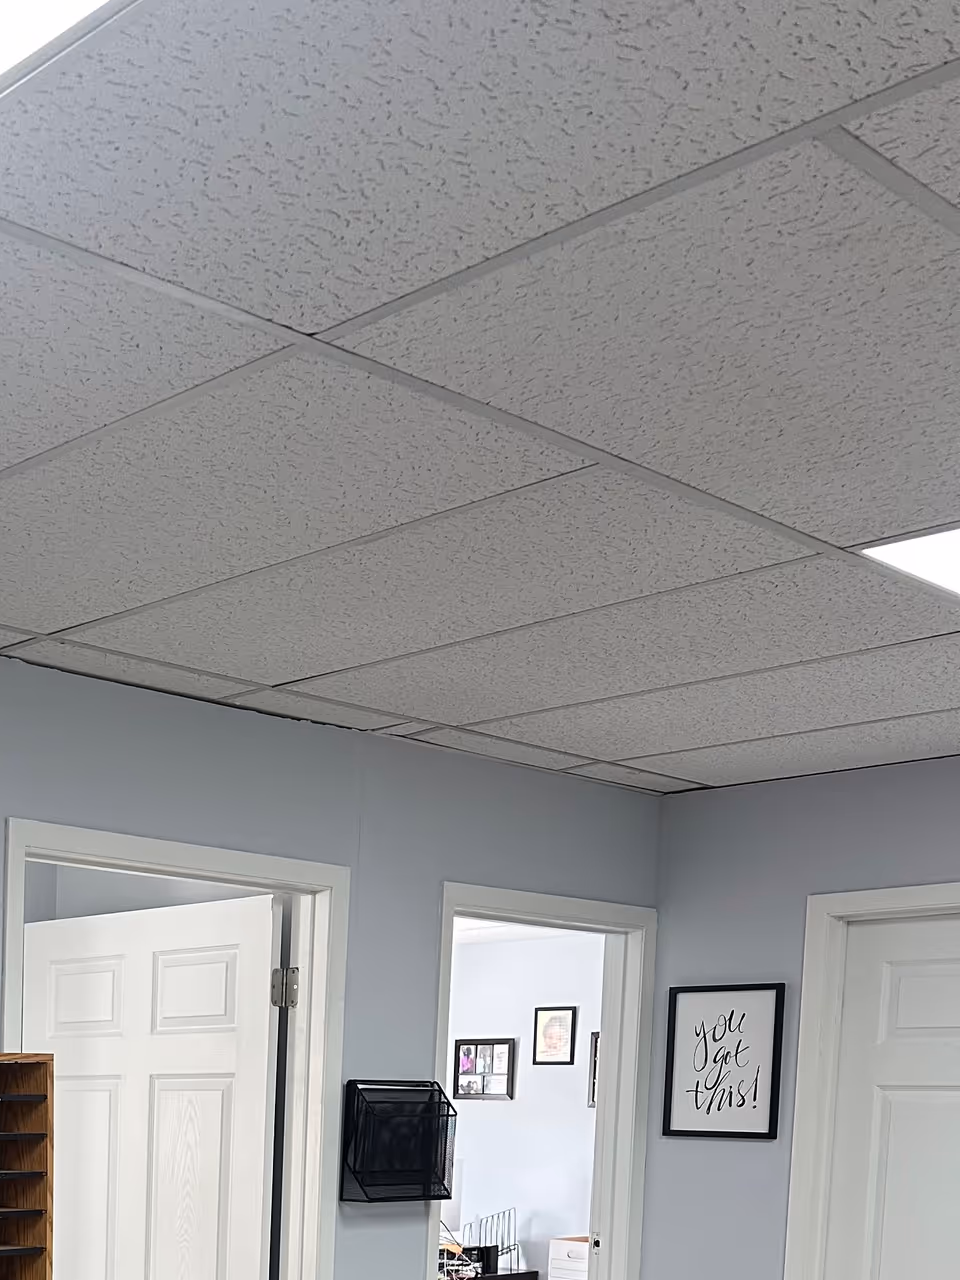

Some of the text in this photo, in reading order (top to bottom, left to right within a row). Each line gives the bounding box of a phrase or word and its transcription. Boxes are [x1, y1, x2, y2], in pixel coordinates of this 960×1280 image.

[693, 1009, 746, 1073] you
[704, 1038, 750, 1091] got
[686, 1064, 761, 1116] this!
